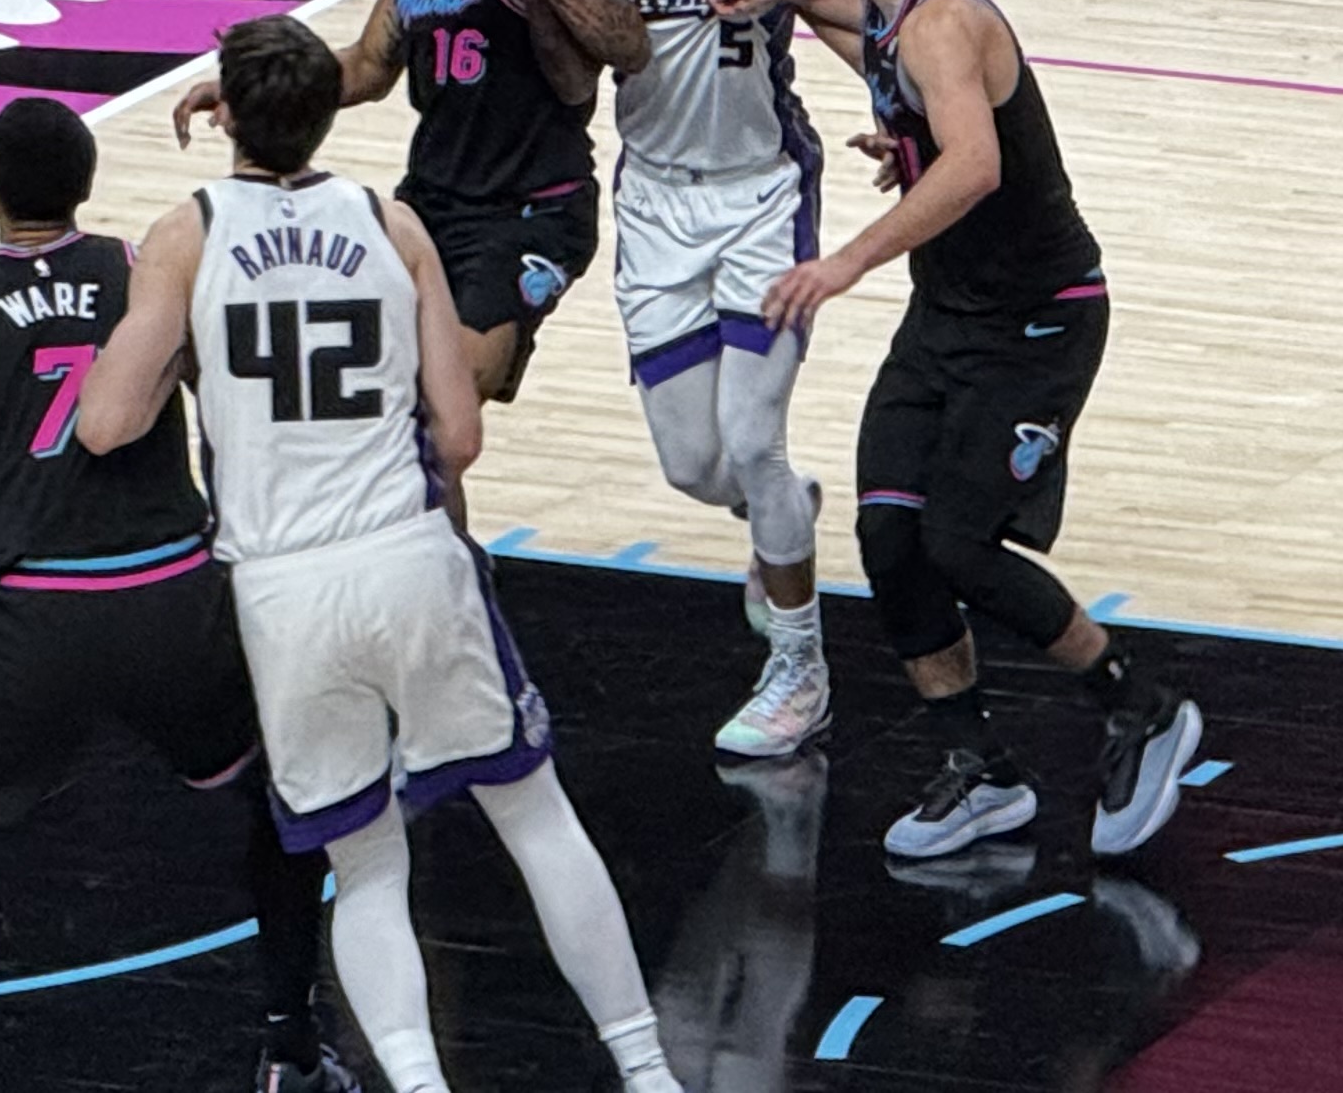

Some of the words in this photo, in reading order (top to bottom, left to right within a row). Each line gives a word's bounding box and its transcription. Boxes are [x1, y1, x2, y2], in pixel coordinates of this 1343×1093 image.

[432, 27, 490, 86] 16
[718, 18, 755, 68] 5
[230, 226, 368, 281] RAYNAUD
[226, 298, 383, 423] 42
[28, 343, 98, 459] 7
